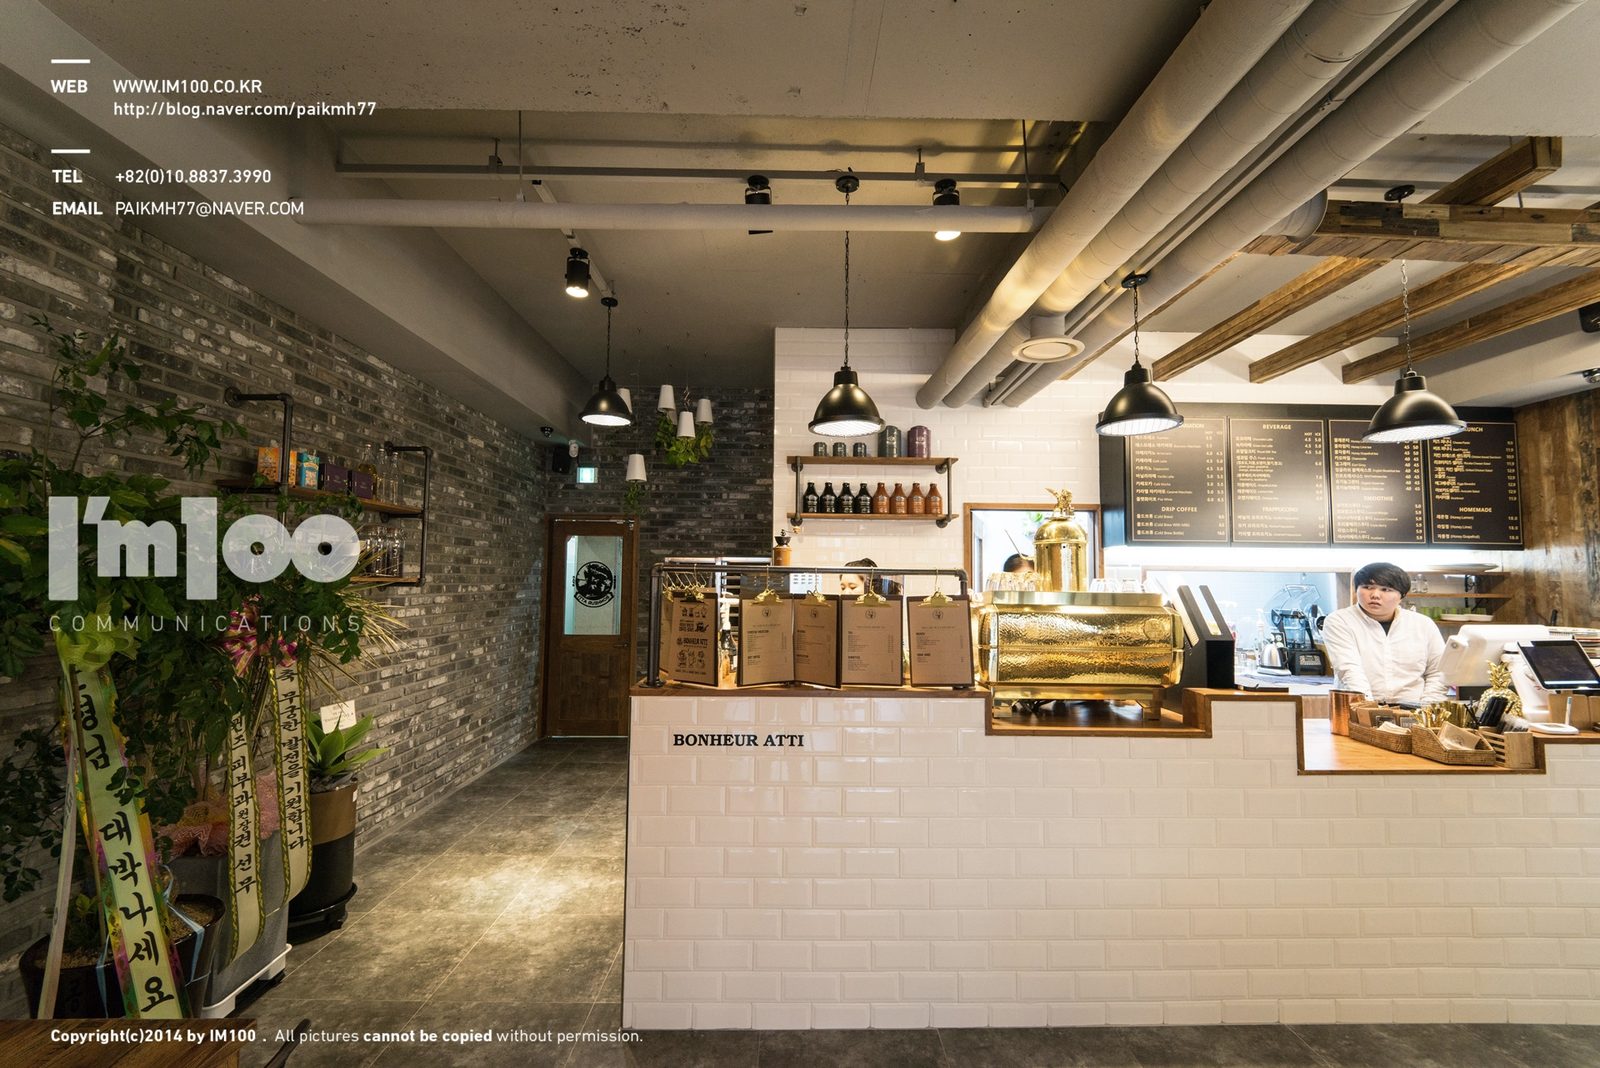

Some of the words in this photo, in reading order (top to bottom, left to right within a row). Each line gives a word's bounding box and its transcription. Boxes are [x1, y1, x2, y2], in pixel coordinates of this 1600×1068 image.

[275, 668, 299, 682] 축
[278, 690, 301, 732] 무궁한
[280, 736, 303, 779] 발전을
[673, 734, 758, 747] BONHEUR
[763, 734, 804, 747] ATTI
[231, 755, 253, 808] 피부과
[284, 781, 309, 850] 기원합니다
[99, 810, 175, 1013] 대박나세요
